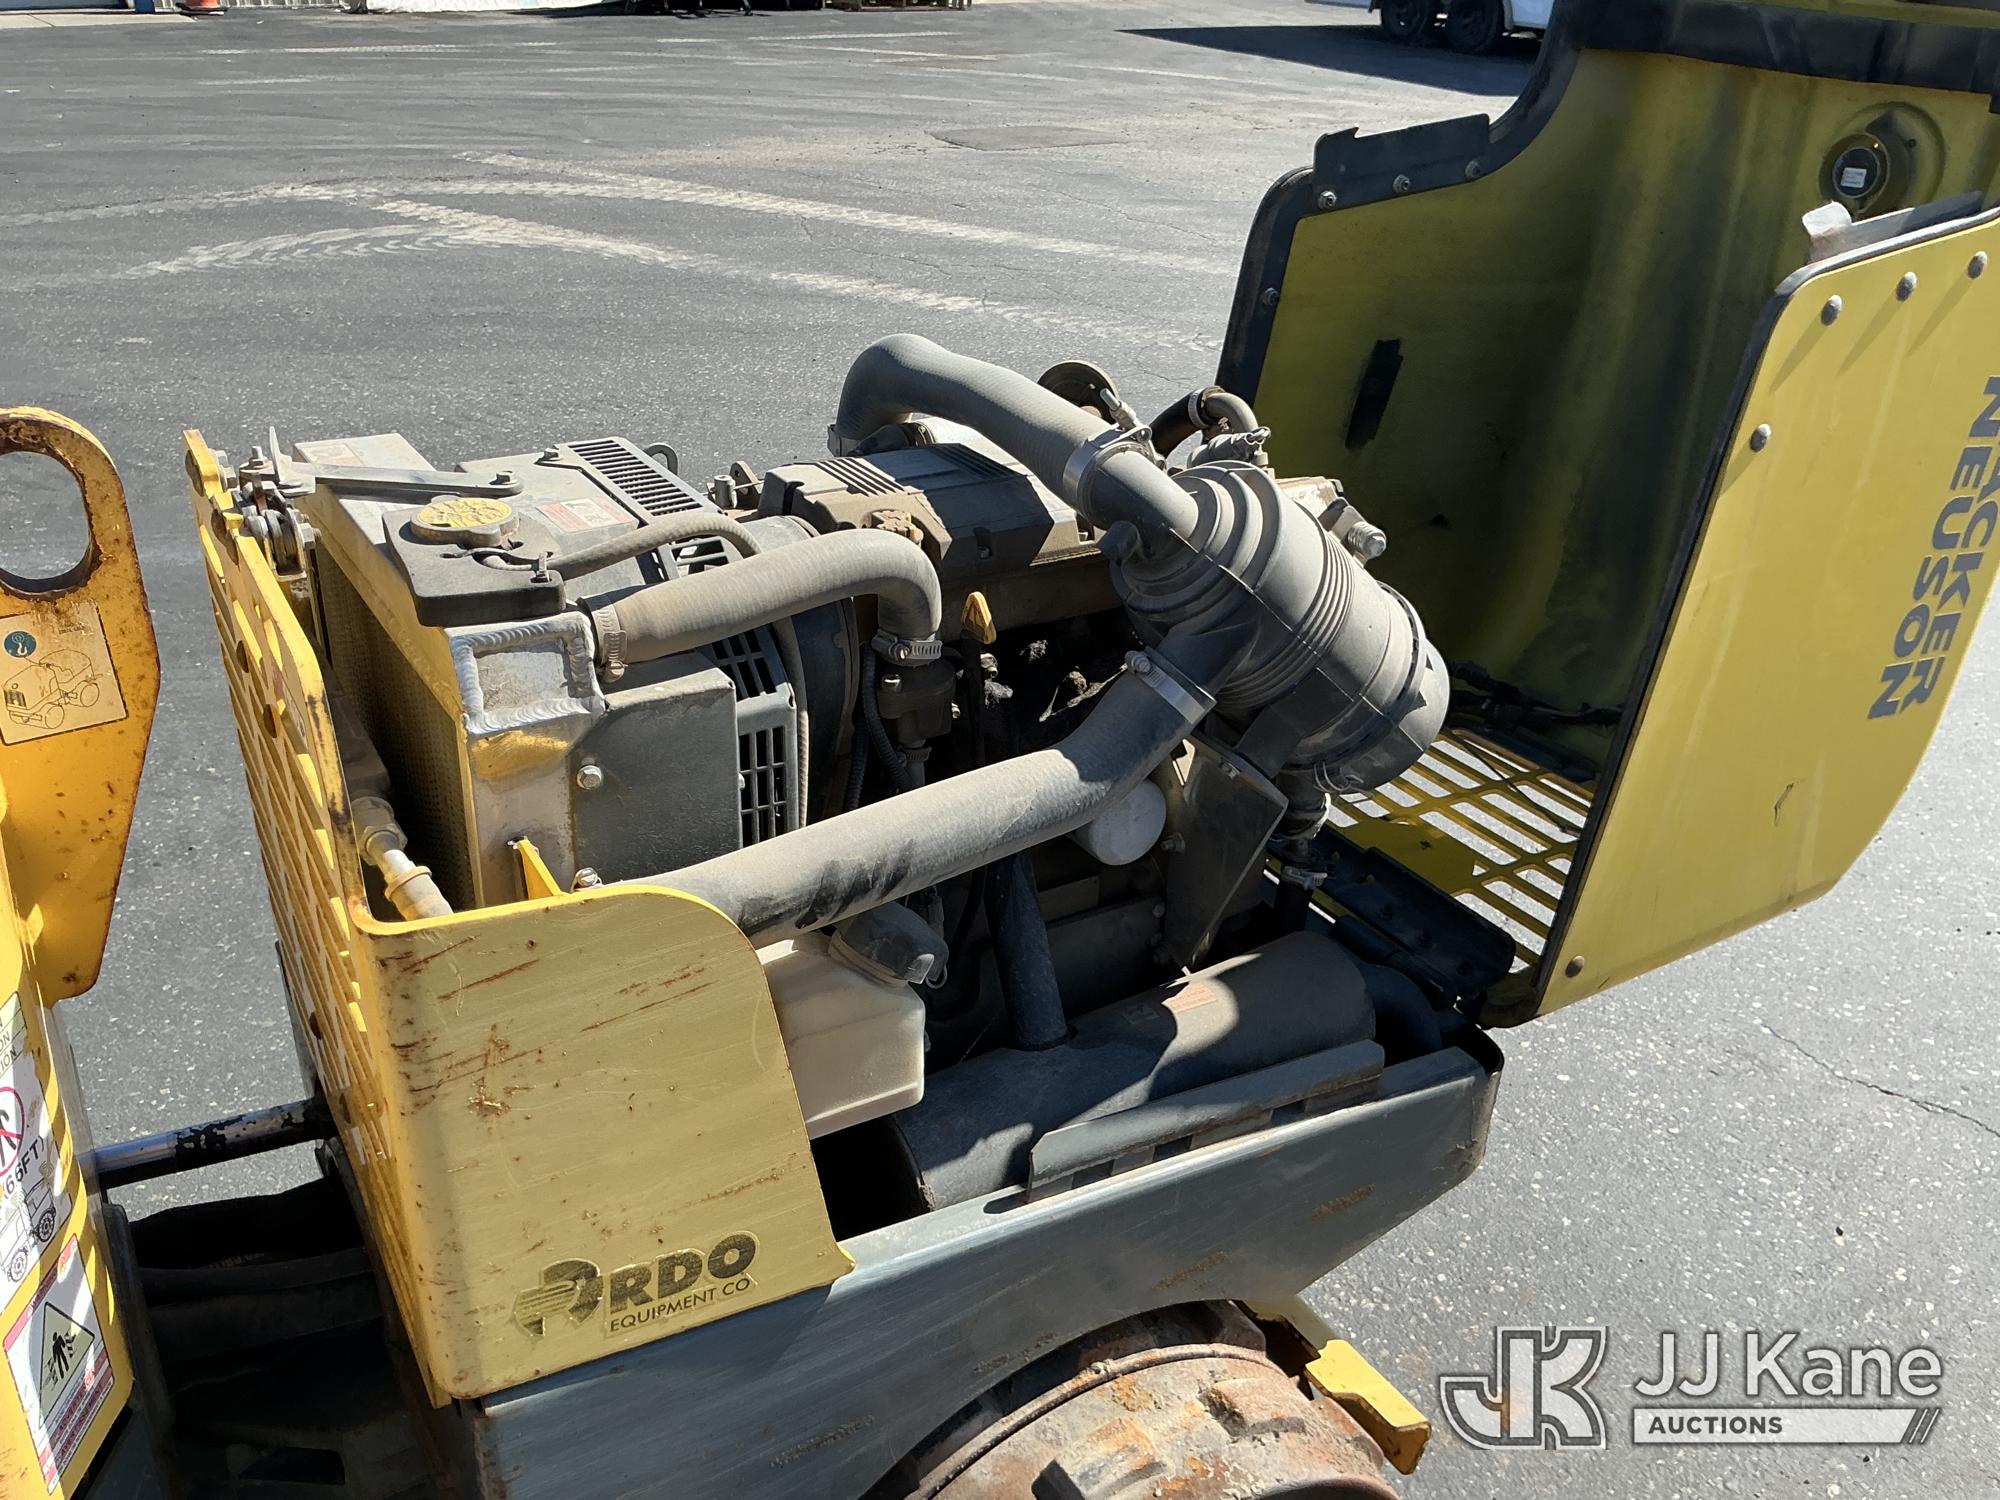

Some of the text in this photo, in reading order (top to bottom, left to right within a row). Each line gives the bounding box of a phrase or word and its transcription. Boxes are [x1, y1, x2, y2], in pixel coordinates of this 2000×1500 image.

[1867, 376, 2000, 720] NEUSON
[610, 1233, 756, 1314] RDO
[610, 1287, 717, 1332] EQUIPMENT
